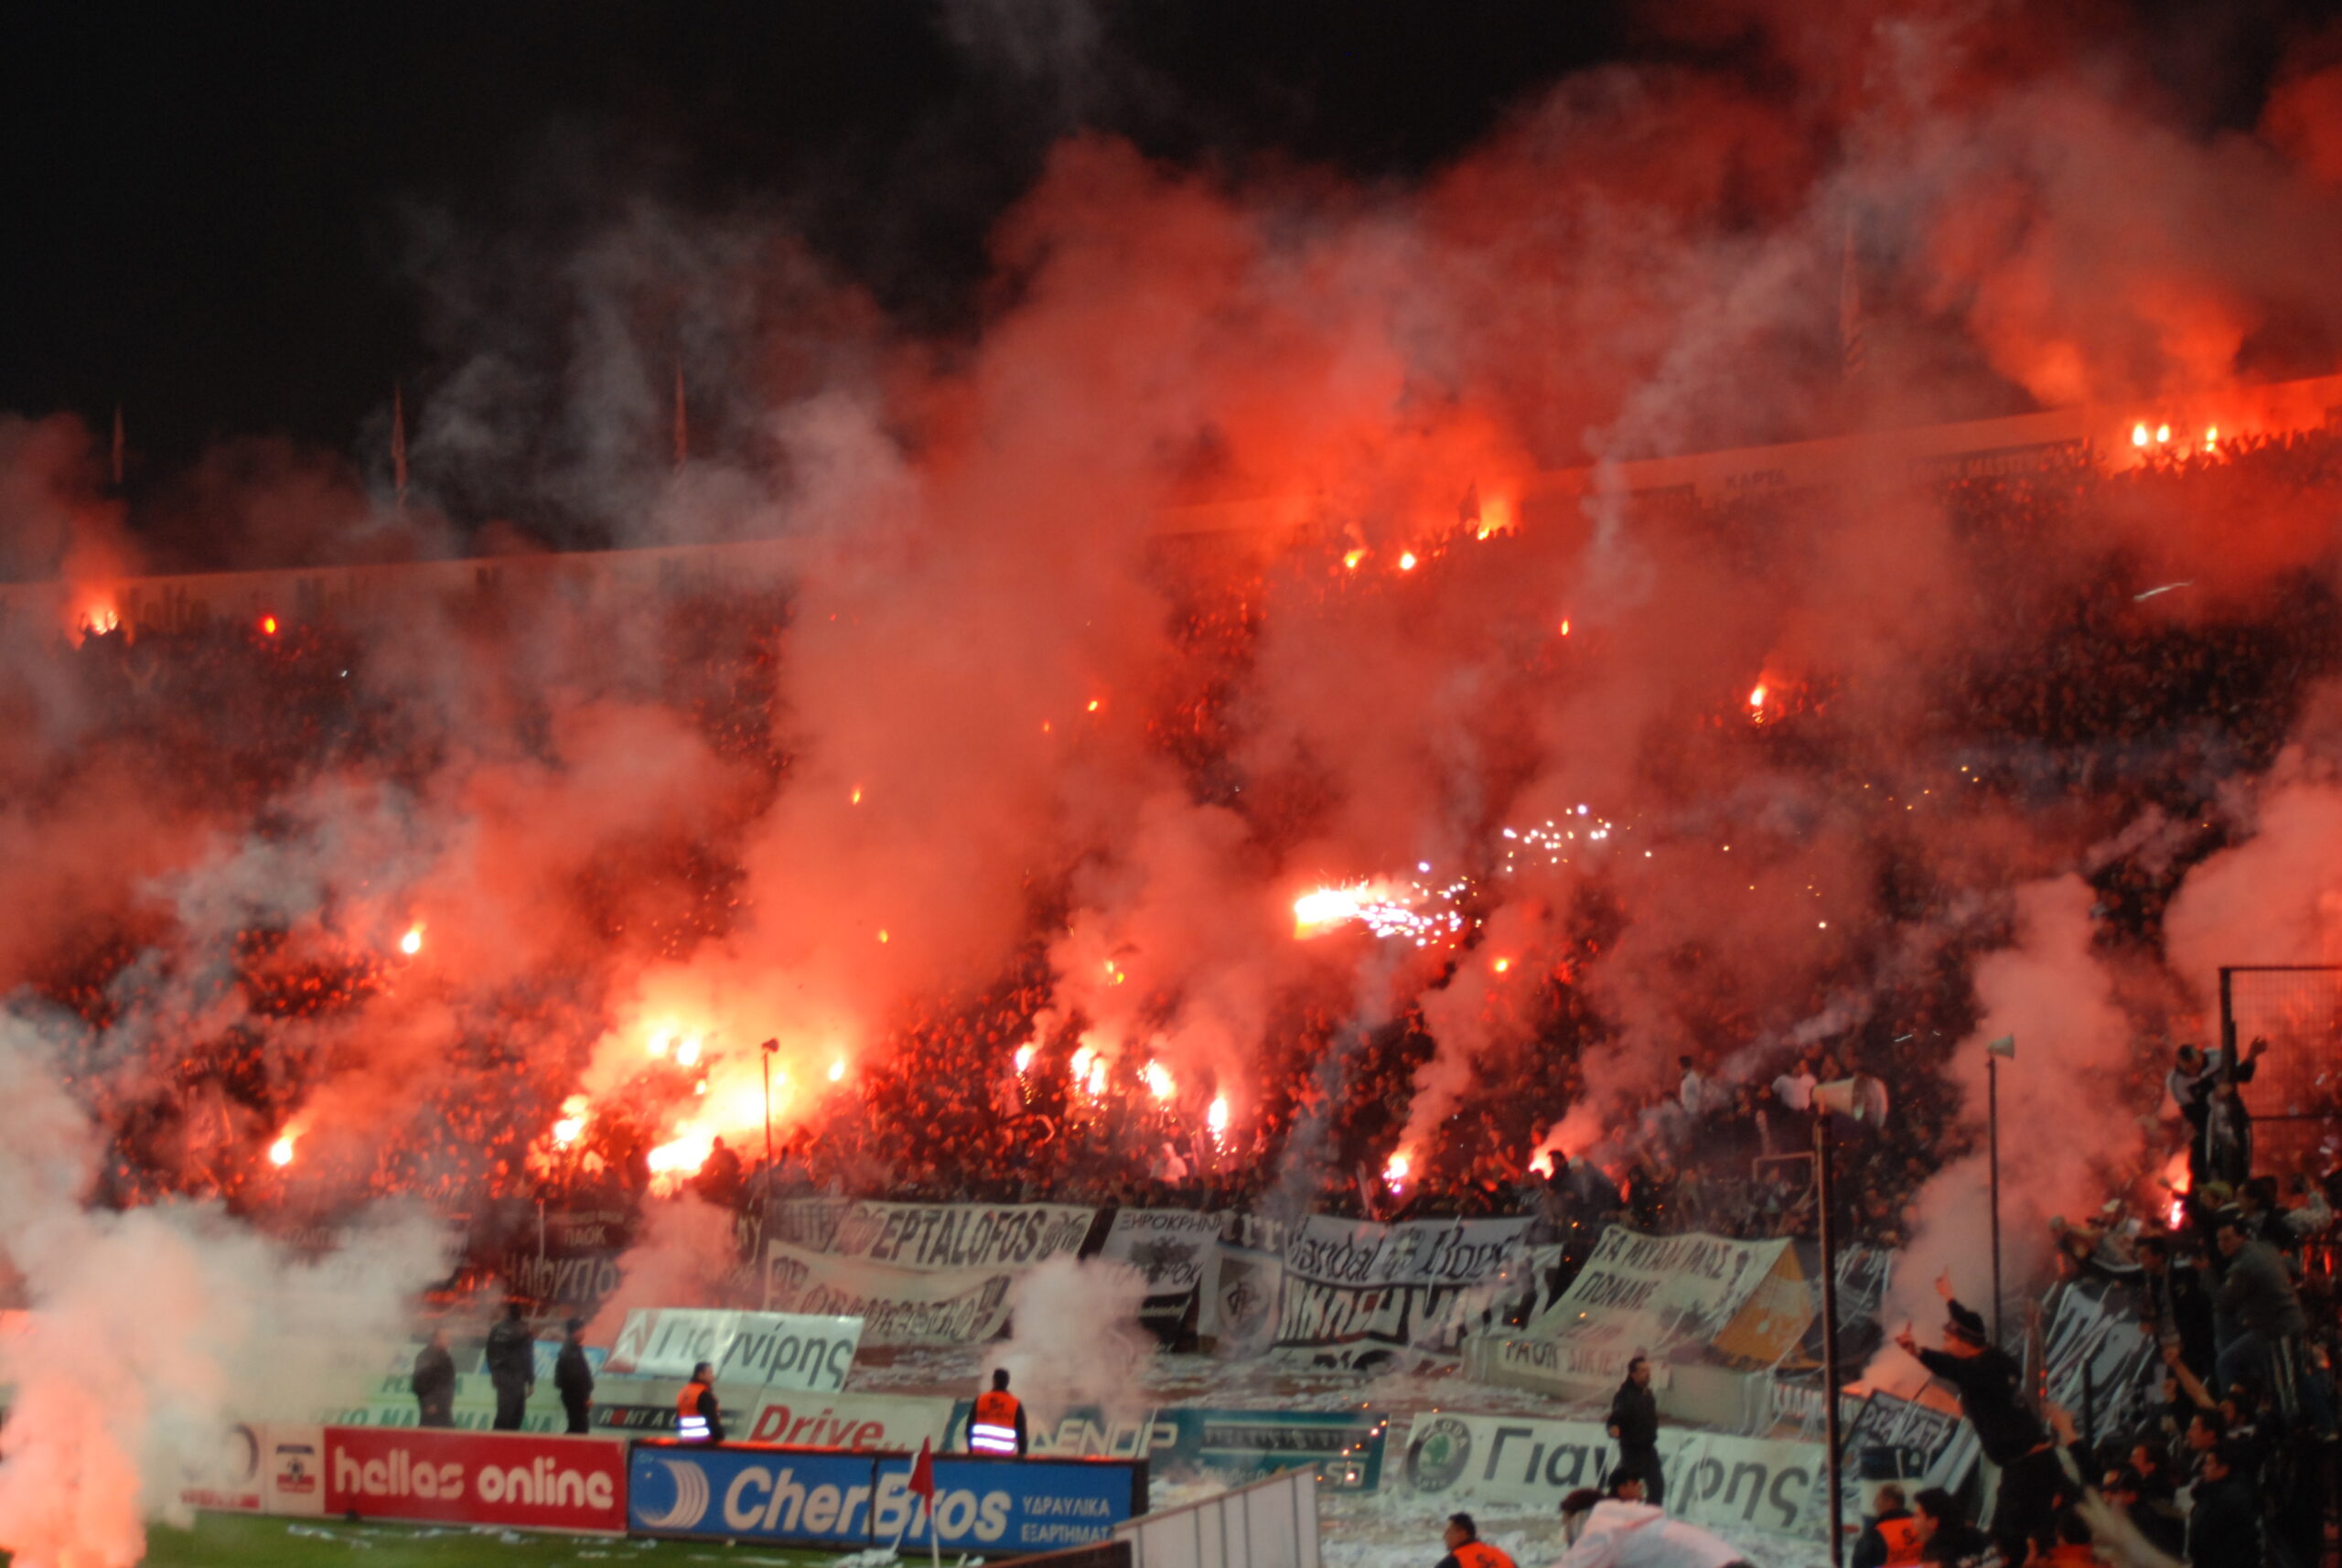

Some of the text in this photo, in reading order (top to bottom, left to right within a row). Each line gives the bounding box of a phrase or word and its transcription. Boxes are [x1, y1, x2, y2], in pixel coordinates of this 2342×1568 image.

[869, 1208, 1047, 1266] EPTALOFOS
[747, 1402, 885, 1452] Drive
[335, 1447, 614, 1509] hellas online
[724, 1465, 1012, 1541] CherBros
[1482, 1424, 1809, 1526] Γιανίρης
[1021, 1522, 1114, 1545] ΕΞΑΡΤΗΜΑΤ
[1022, 1495, 1111, 1518] ΥΔΡΑΥΛΙΚΑ
